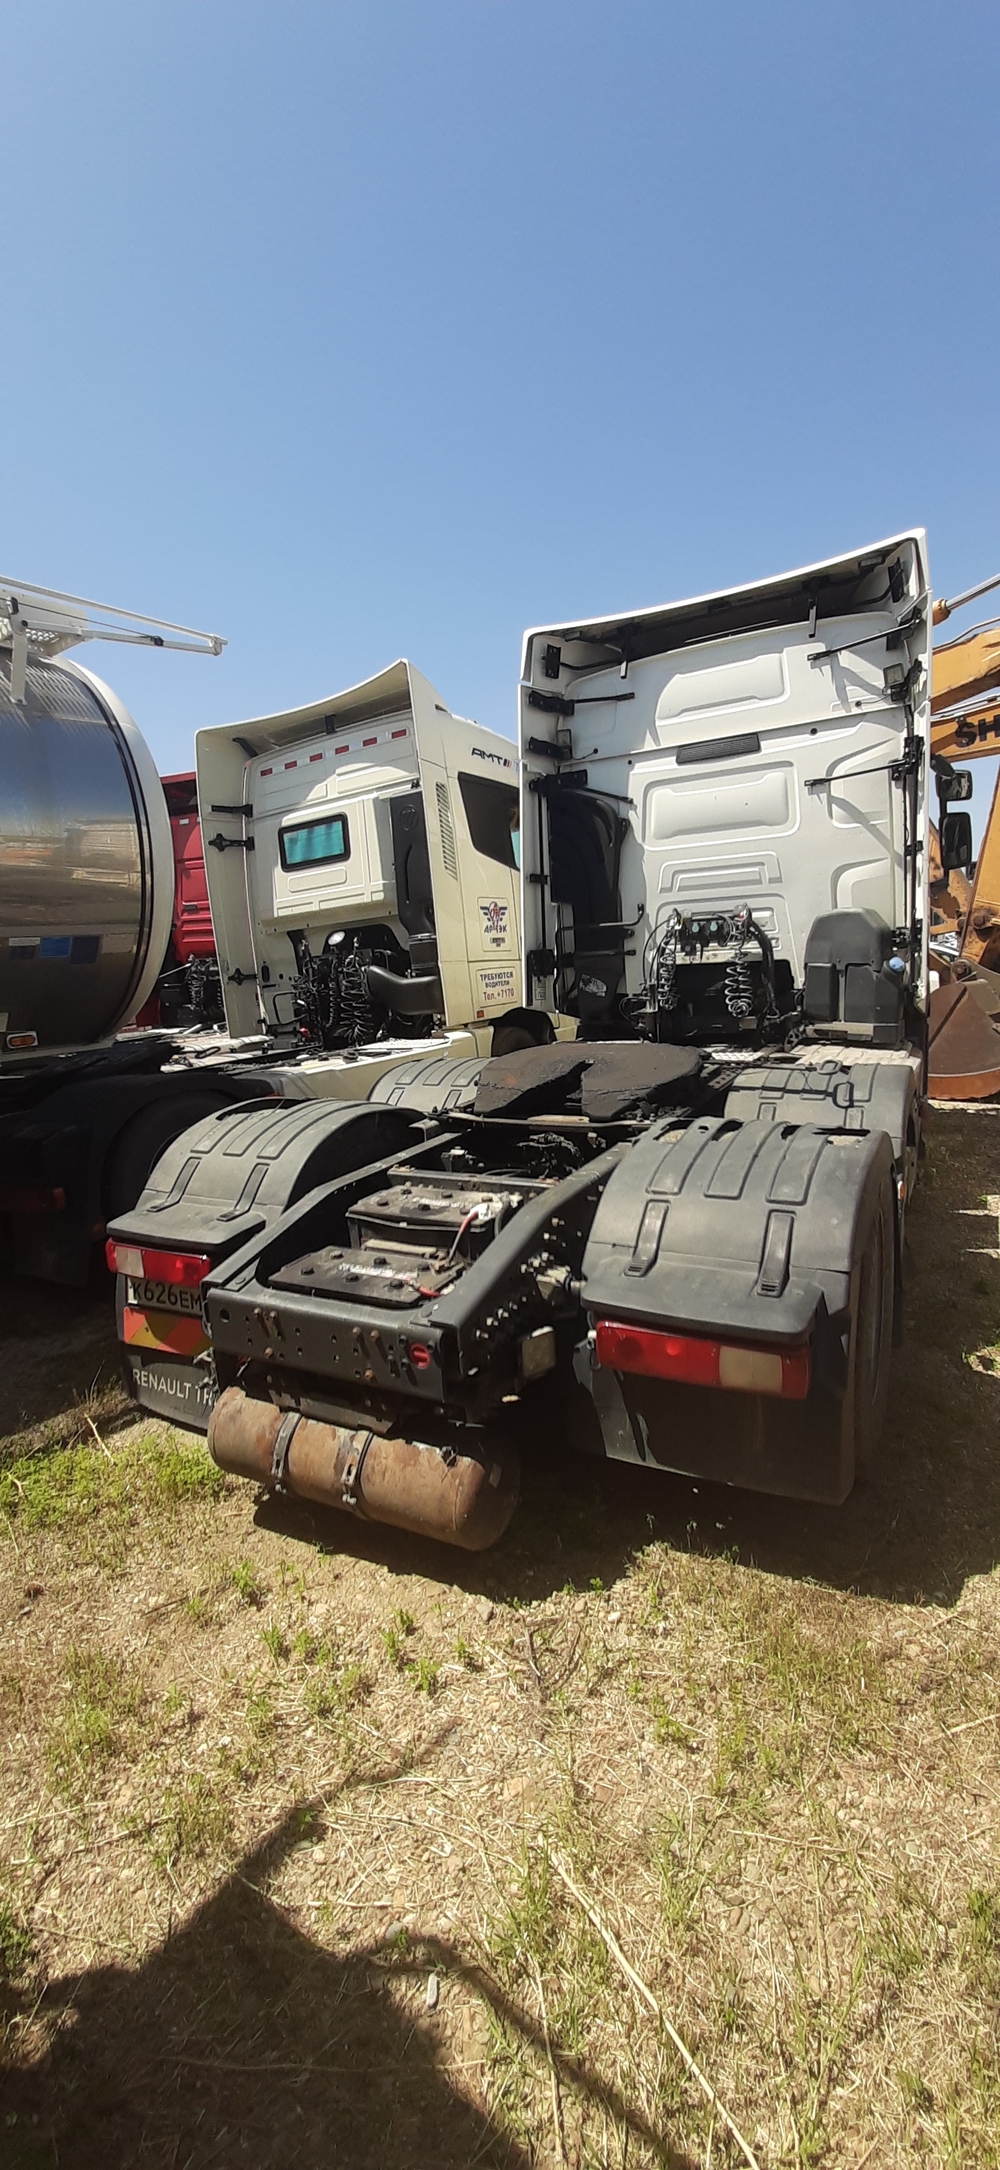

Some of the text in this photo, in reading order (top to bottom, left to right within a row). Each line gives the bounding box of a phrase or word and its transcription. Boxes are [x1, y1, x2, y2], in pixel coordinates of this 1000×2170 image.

[480, 971, 514, 981] ТРЕБУЮТСЯ
[132, 1368, 217, 1406] RENAULT TR
